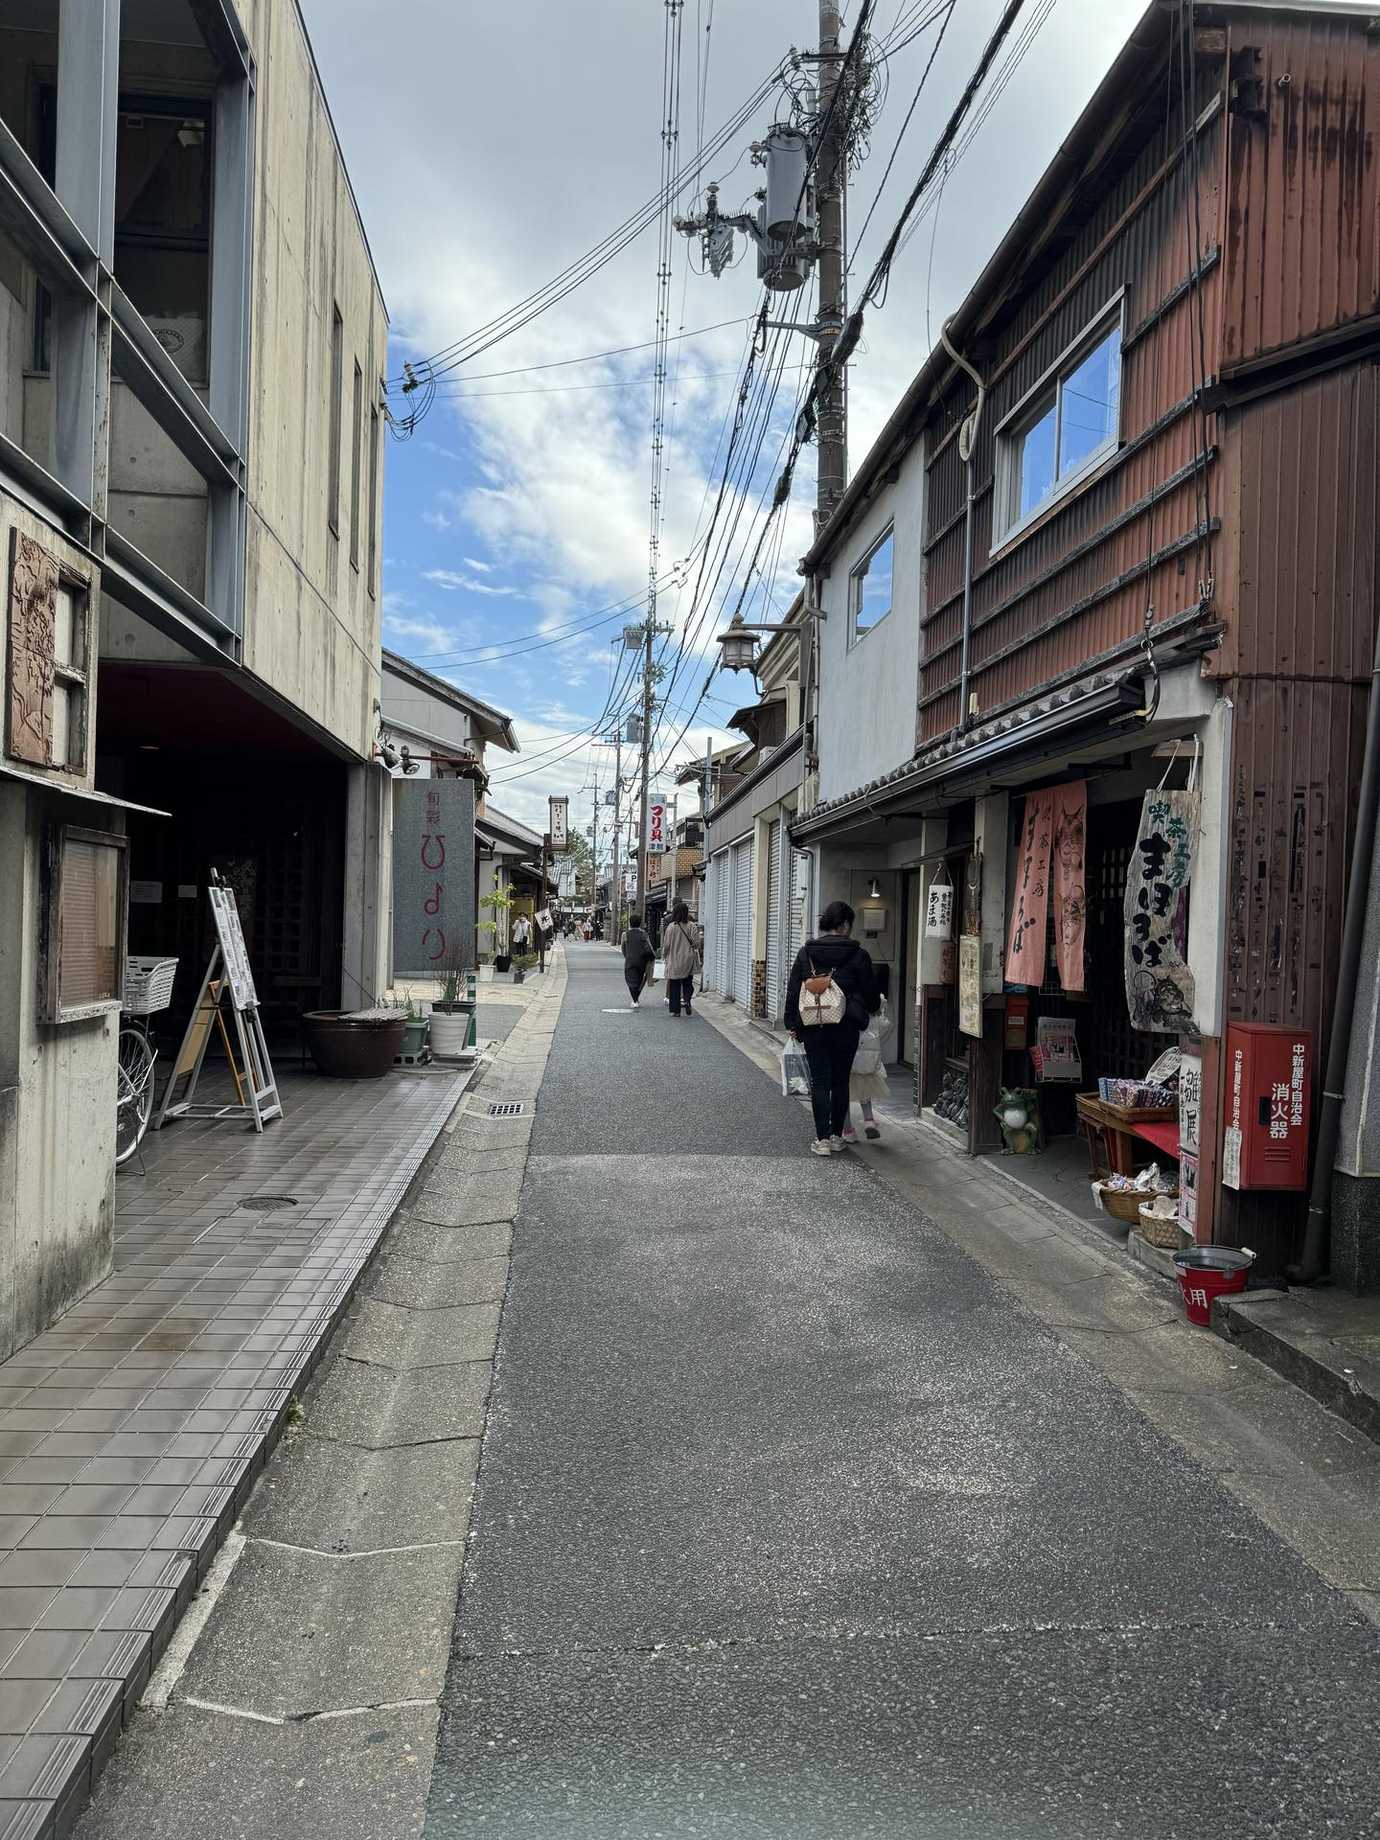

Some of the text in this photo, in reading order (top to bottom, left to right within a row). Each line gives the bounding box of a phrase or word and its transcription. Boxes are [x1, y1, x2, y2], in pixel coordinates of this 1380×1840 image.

[650, 804, 664, 842] つり具
[1148, 798, 1191, 889] 喫茶工房
[420, 834, 447, 961] ひより
[928, 892, 939, 928] あま酒
[1132, 831, 1173, 968] まほろば
[1269, 1082, 1290, 1140] 消火器
[1291, 1043, 1305, 1126] 中新屋町自治会
